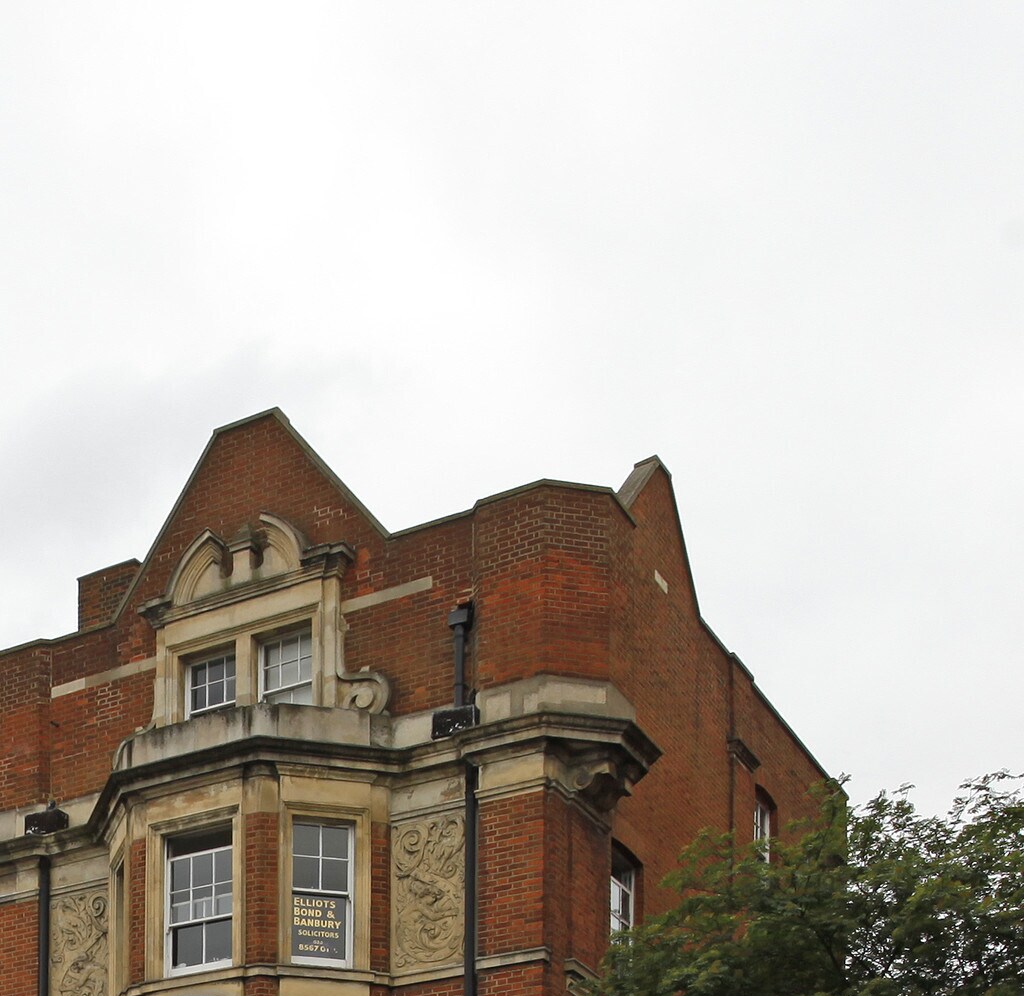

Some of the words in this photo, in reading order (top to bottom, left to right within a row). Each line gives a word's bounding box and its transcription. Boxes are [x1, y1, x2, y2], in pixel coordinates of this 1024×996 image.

[293, 897, 336, 909] ELLIOTS
[293, 906, 322, 917] BOND
[326, 911, 336, 919] &
[293, 917, 342, 929] BANBURY
[298, 929, 339, 938] SOLICITORS
